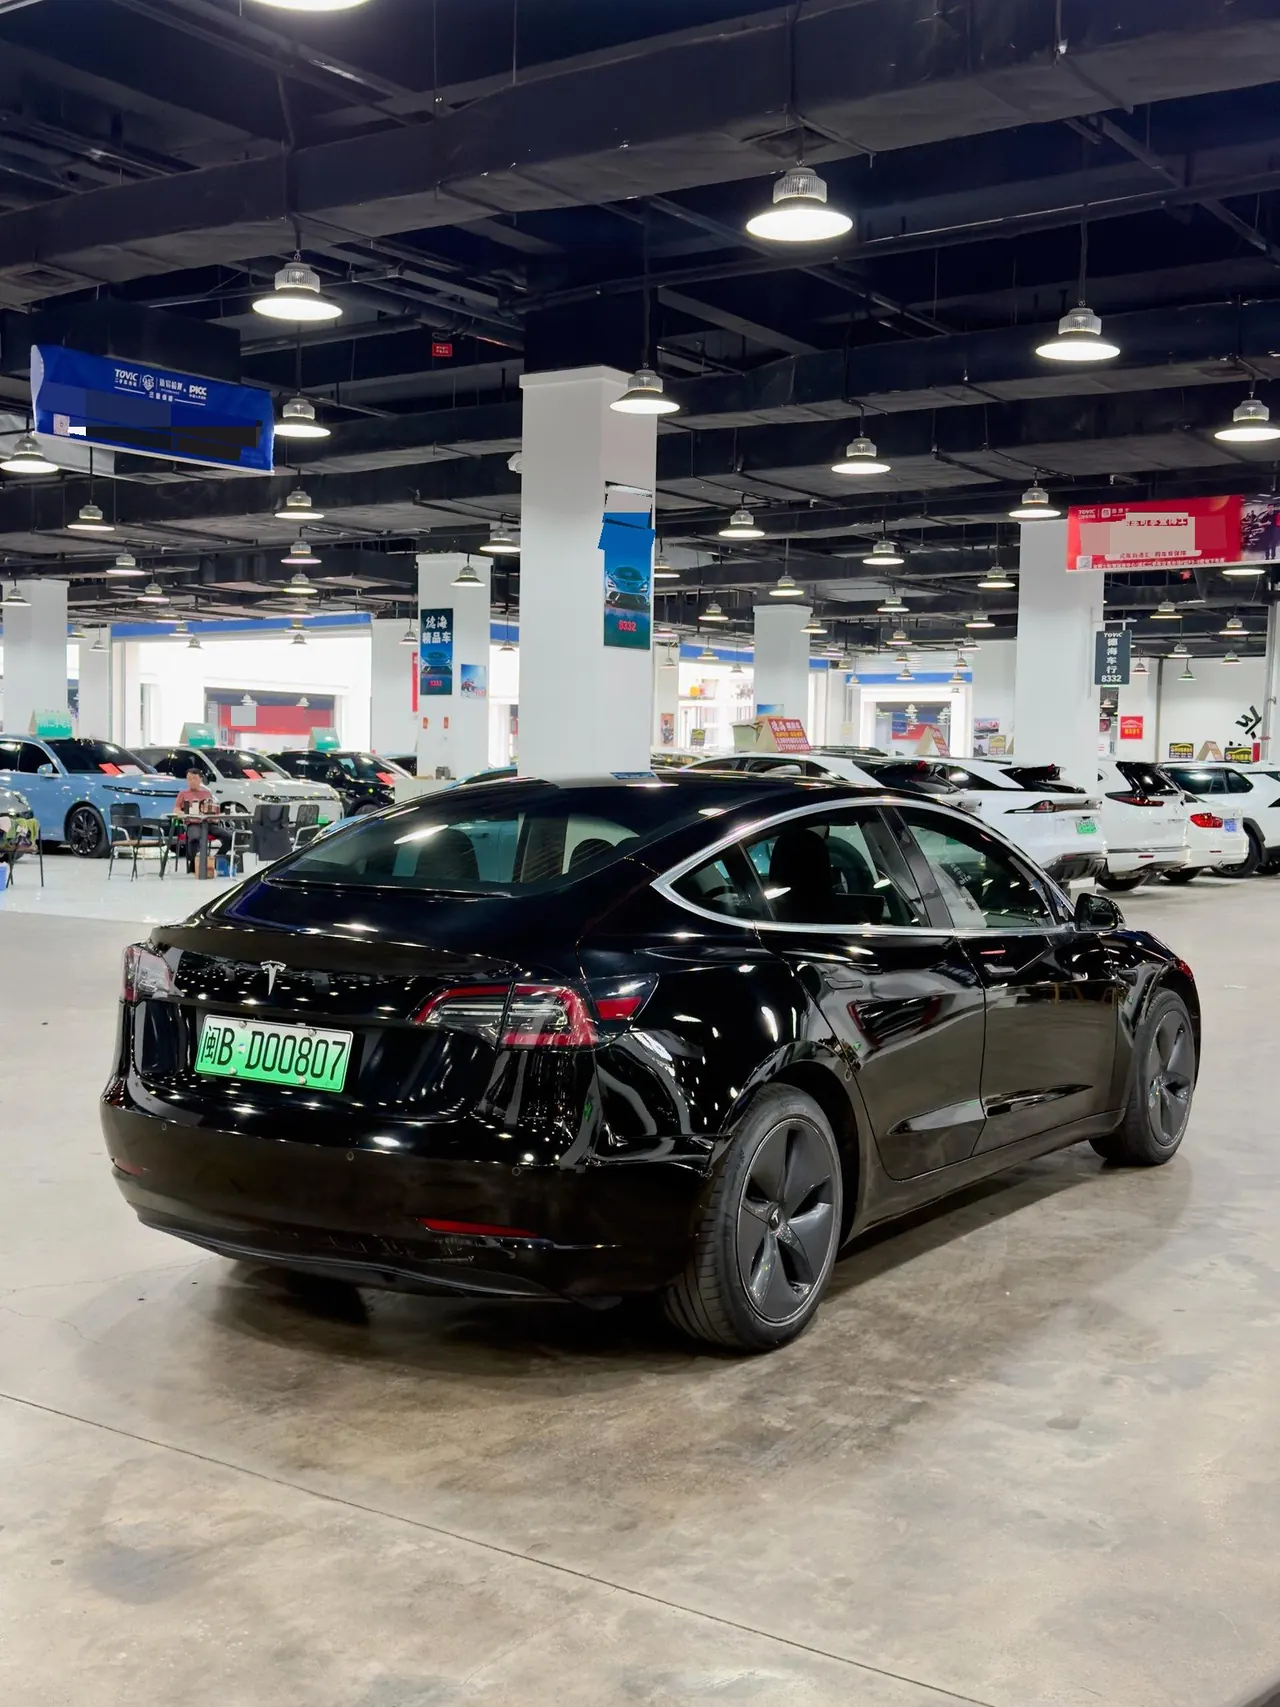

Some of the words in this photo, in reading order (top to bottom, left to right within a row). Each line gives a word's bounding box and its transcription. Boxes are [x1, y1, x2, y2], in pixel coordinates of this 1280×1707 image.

[114, 368, 138, 381] TOVIC
[189, 385, 207, 396] PICC
[422, 631, 452, 644] 精品车
